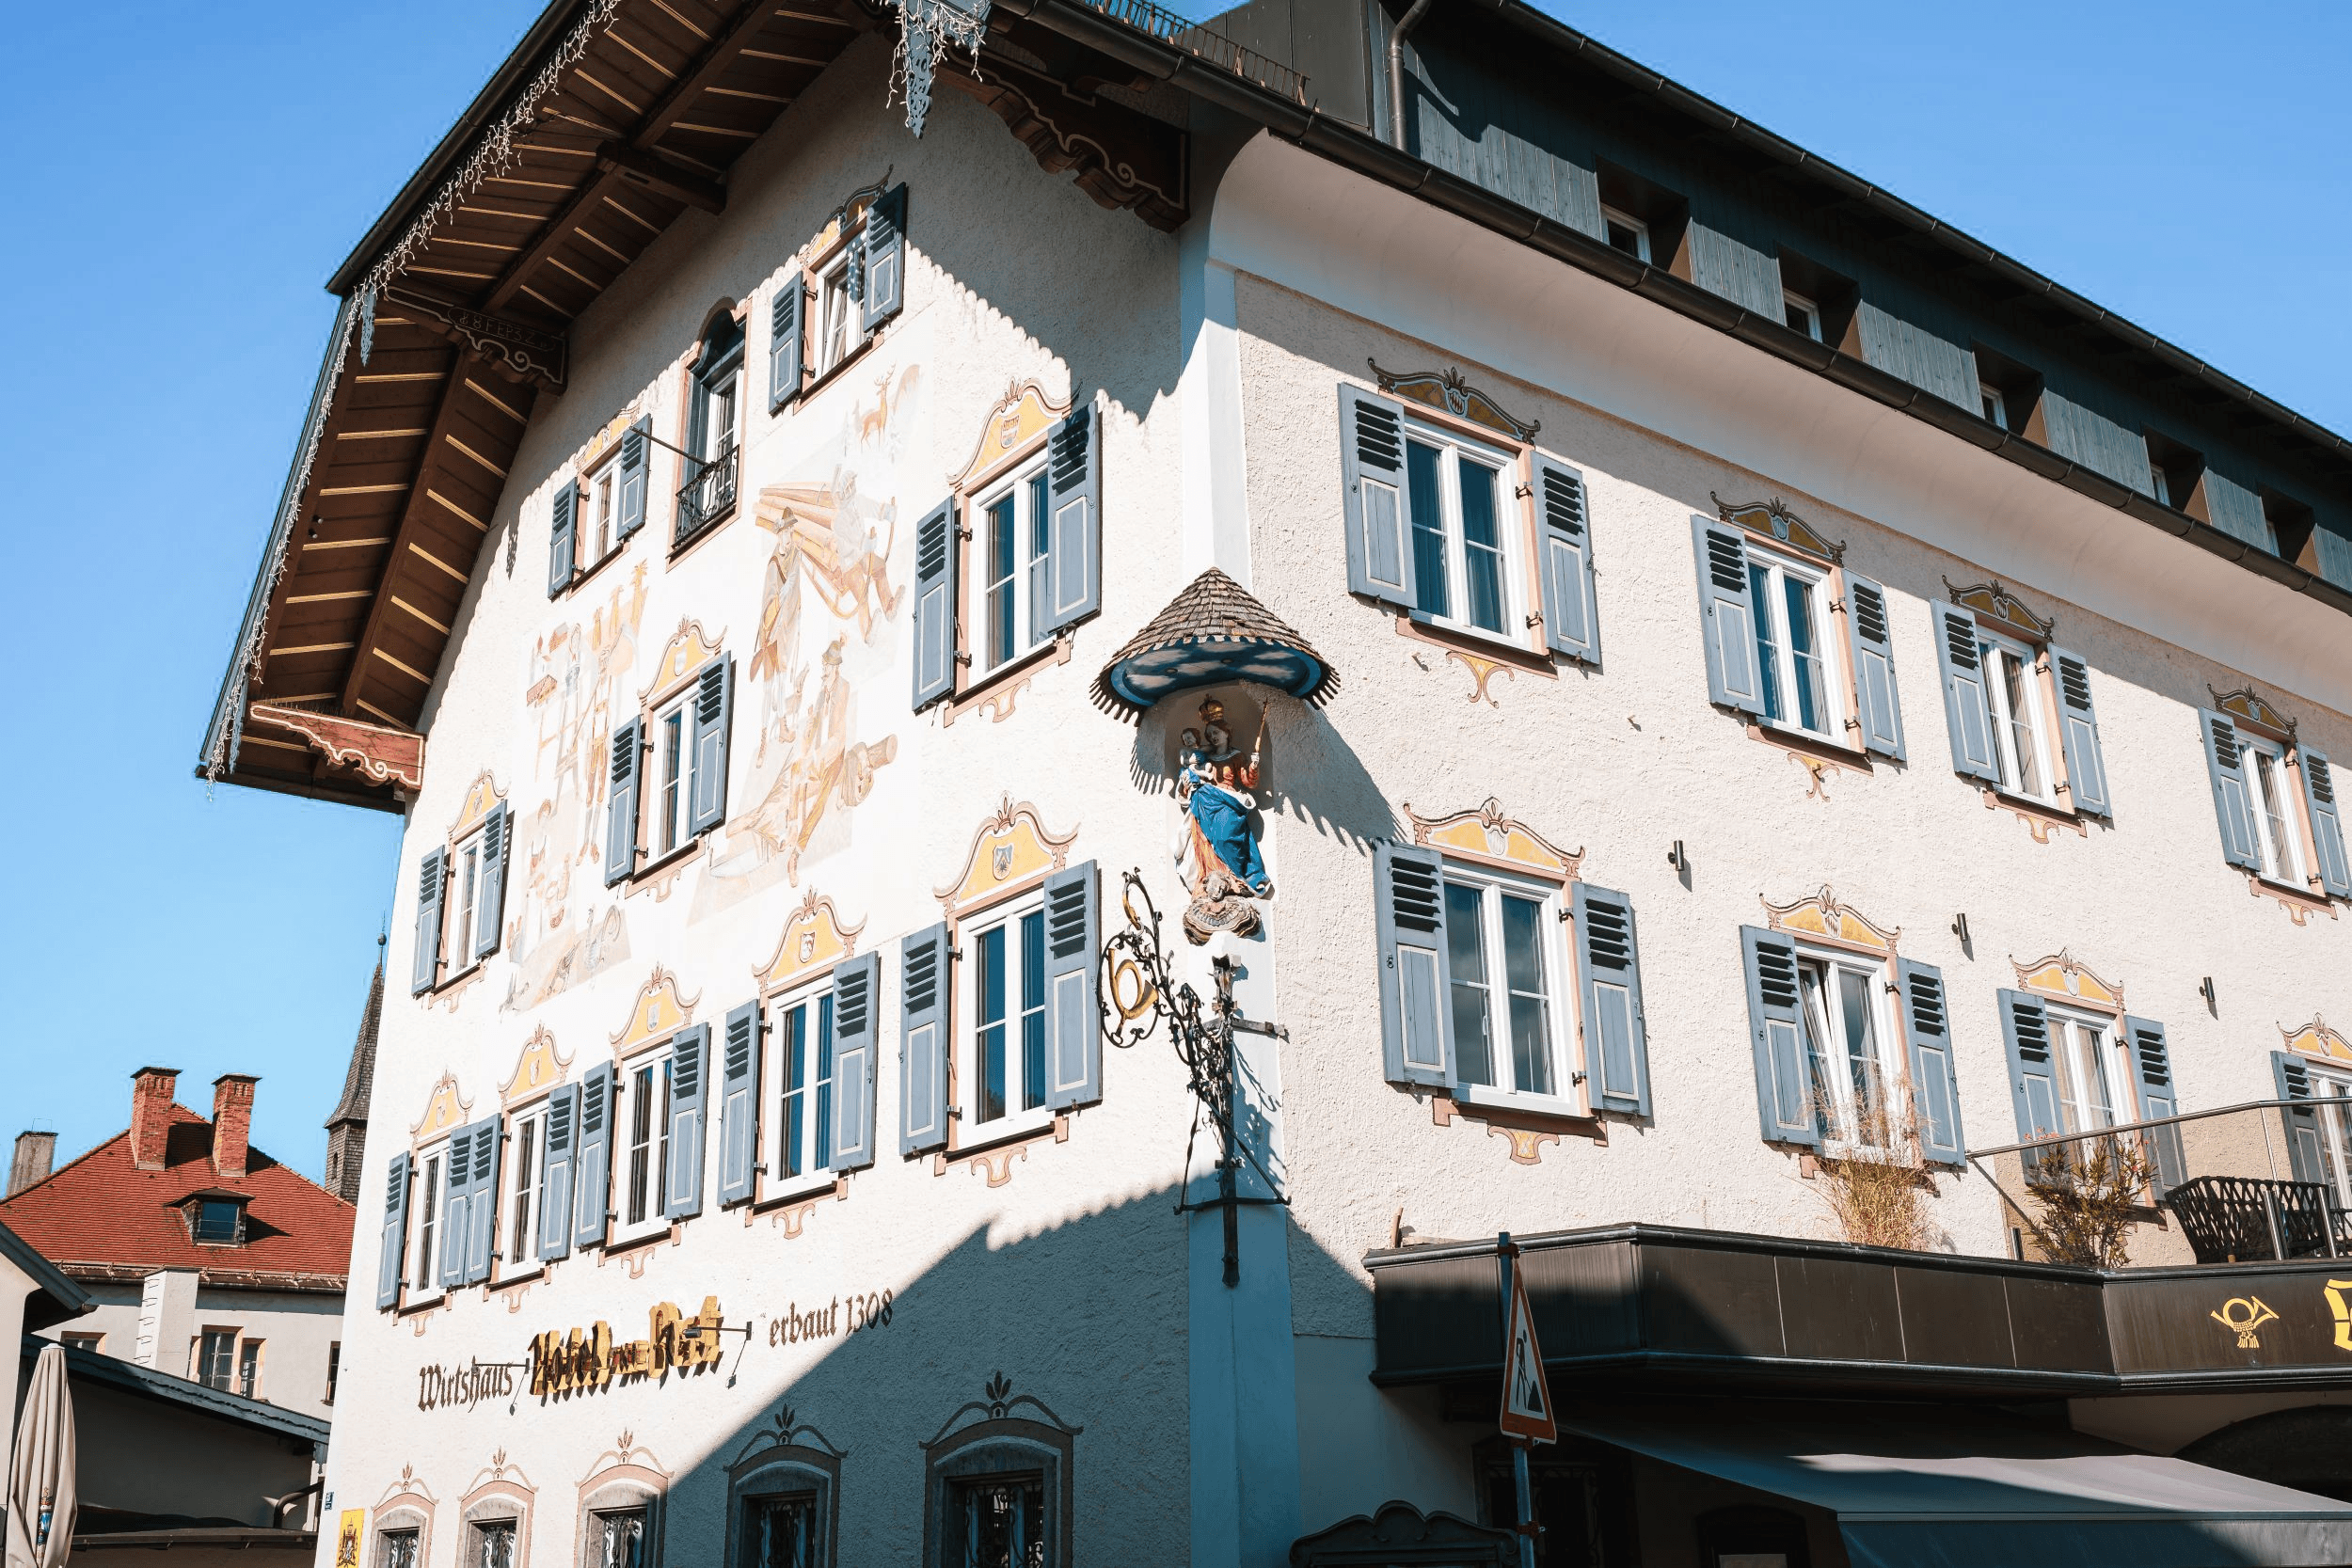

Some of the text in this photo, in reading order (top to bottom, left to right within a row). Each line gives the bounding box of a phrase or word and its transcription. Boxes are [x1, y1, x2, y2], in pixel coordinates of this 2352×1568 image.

[418, 1355, 513, 1413] Wirtshaus
[770, 1294, 838, 1348] erbaut
[846, 1288, 893, 1336] 1308
